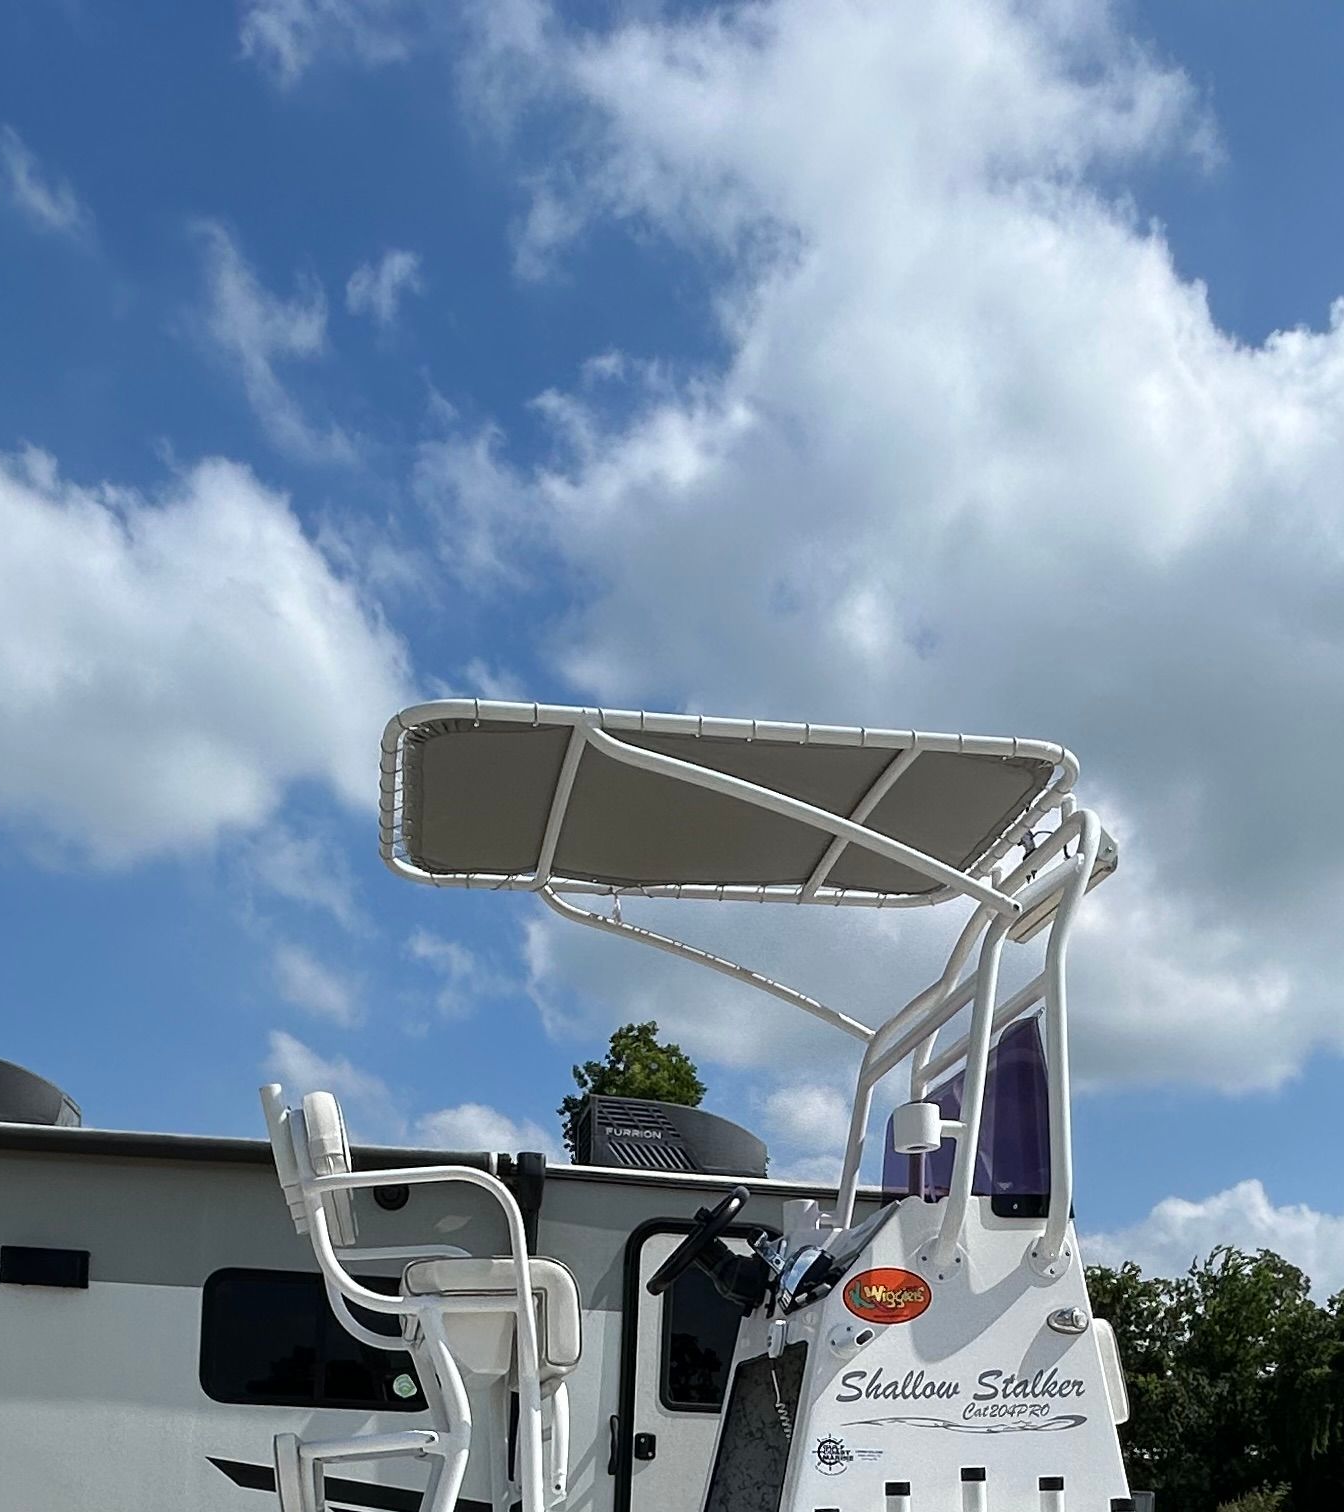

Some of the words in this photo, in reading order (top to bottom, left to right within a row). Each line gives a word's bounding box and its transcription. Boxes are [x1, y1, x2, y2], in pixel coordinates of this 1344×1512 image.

[605, 1127, 662, 1140] FURRION
[836, 1367, 960, 1402] Shallow
[973, 1367, 1086, 1402] Stalker
[962, 1402, 1050, 1420] Cat204PRO
